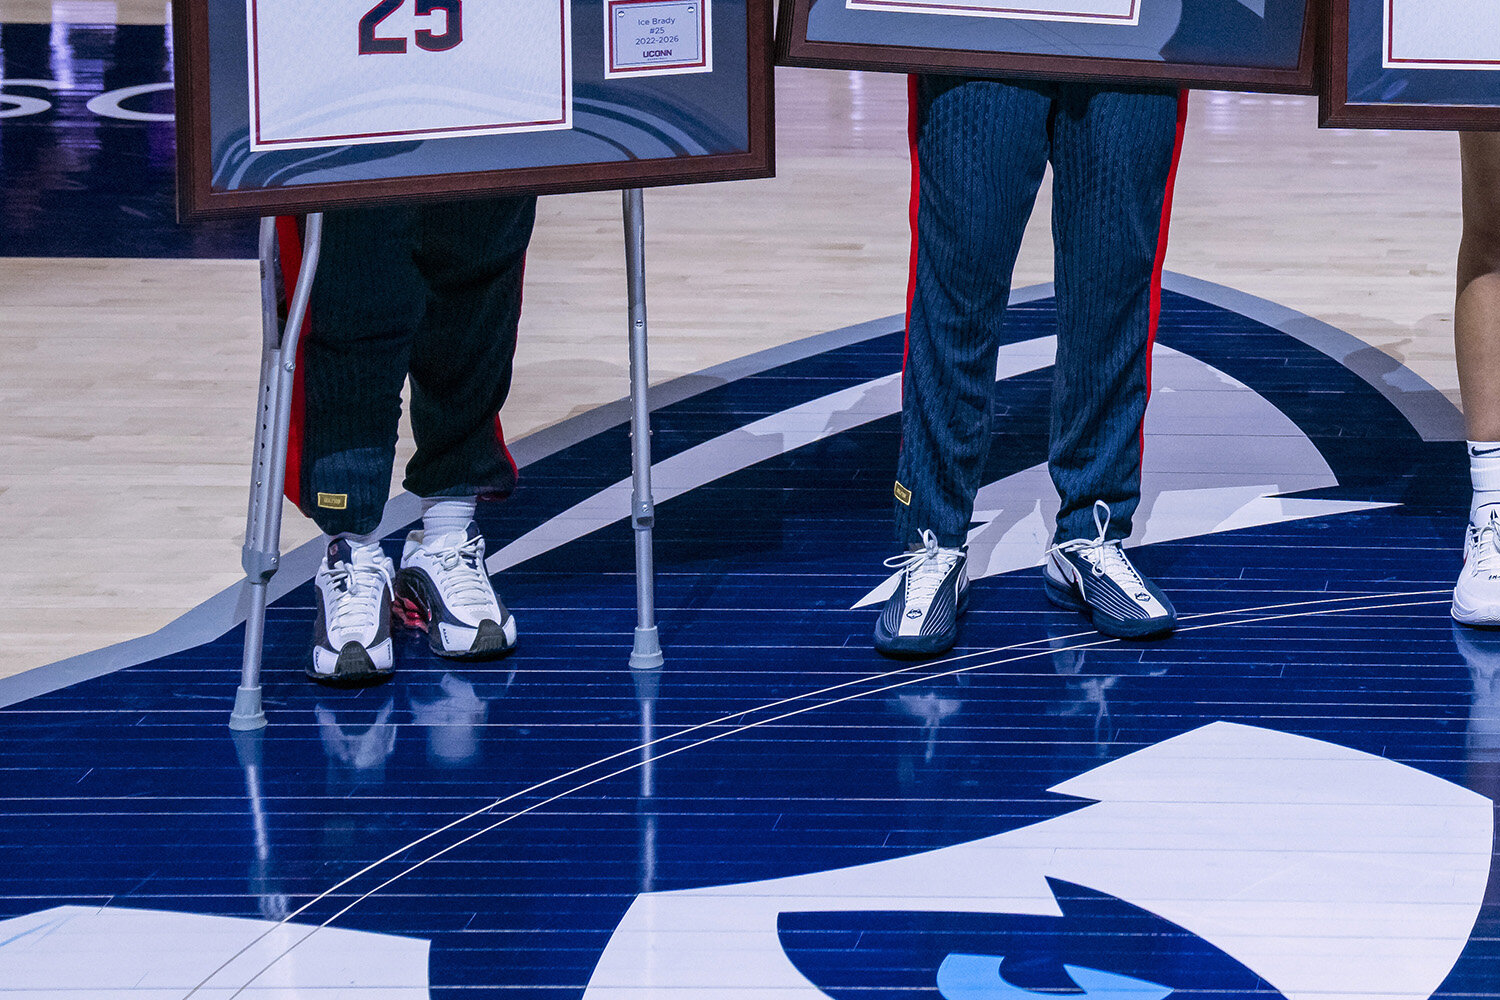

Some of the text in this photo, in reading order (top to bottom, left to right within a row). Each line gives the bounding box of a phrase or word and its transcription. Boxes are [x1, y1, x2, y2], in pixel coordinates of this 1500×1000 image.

[638, 17, 675, 26] Ice Brady
[635, 35, 679, 45] 2022-2026
[643, 49, 672, 58] UCONN
